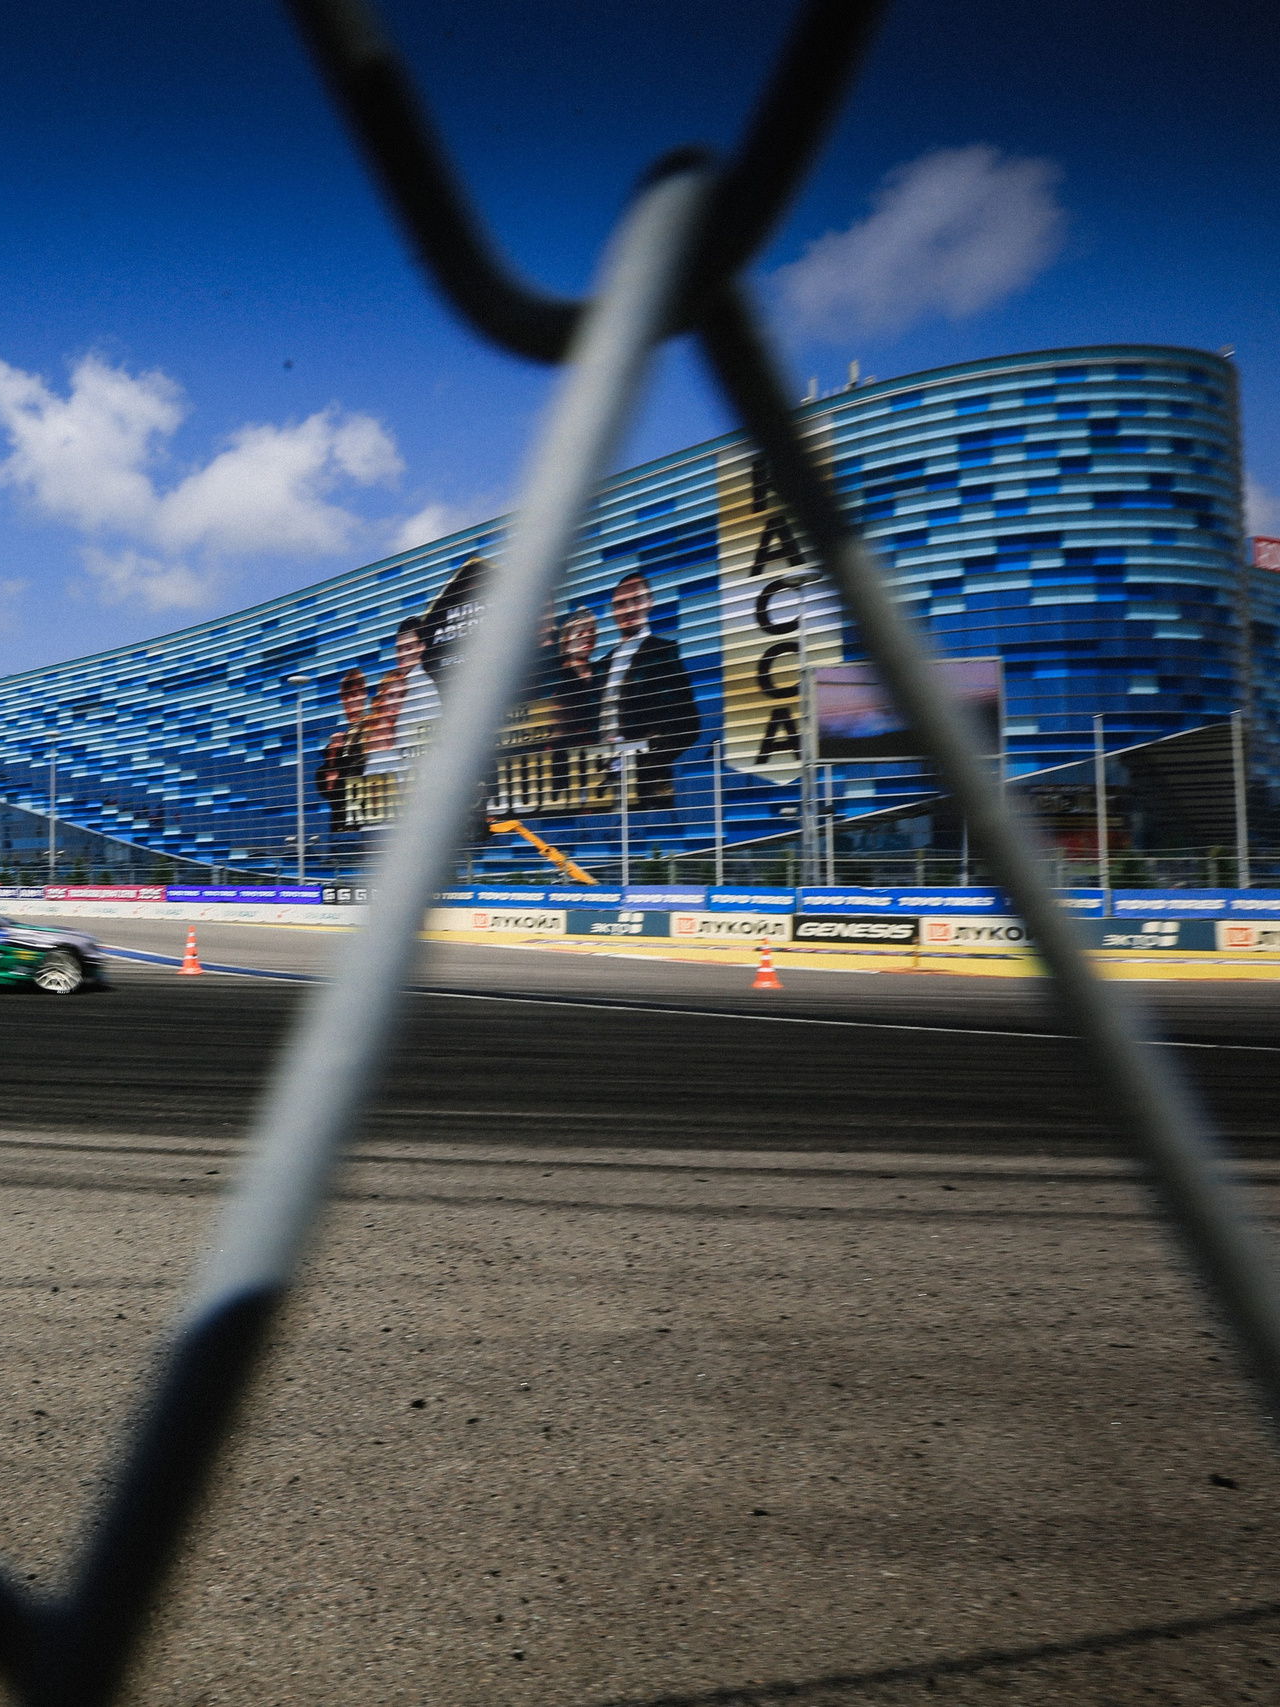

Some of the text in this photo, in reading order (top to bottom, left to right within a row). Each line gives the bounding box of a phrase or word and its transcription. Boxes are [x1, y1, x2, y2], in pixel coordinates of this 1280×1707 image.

[446, 601, 494, 624] ИЛЬ
[432, 618, 486, 645] АВЕР
[478, 892, 545, 900] TOYO TIRES
[548, 893, 621, 902] TOYO TIRES
[625, 894, 706, 903] TOYO TIRES
[710, 895, 796, 905] TOYO TIRES
[803, 896, 893, 906] TOYO TIRES
[898, 896, 943, 907] TOYO
[944, 896, 995, 907] TIRES
[491, 914, 562, 930] ЛУКОЙЛ
[699, 919, 786, 936] ЛУКОЙЛ
[796, 922, 916, 939] GENESIS
[953, 924, 1032, 942] ЛУКО
